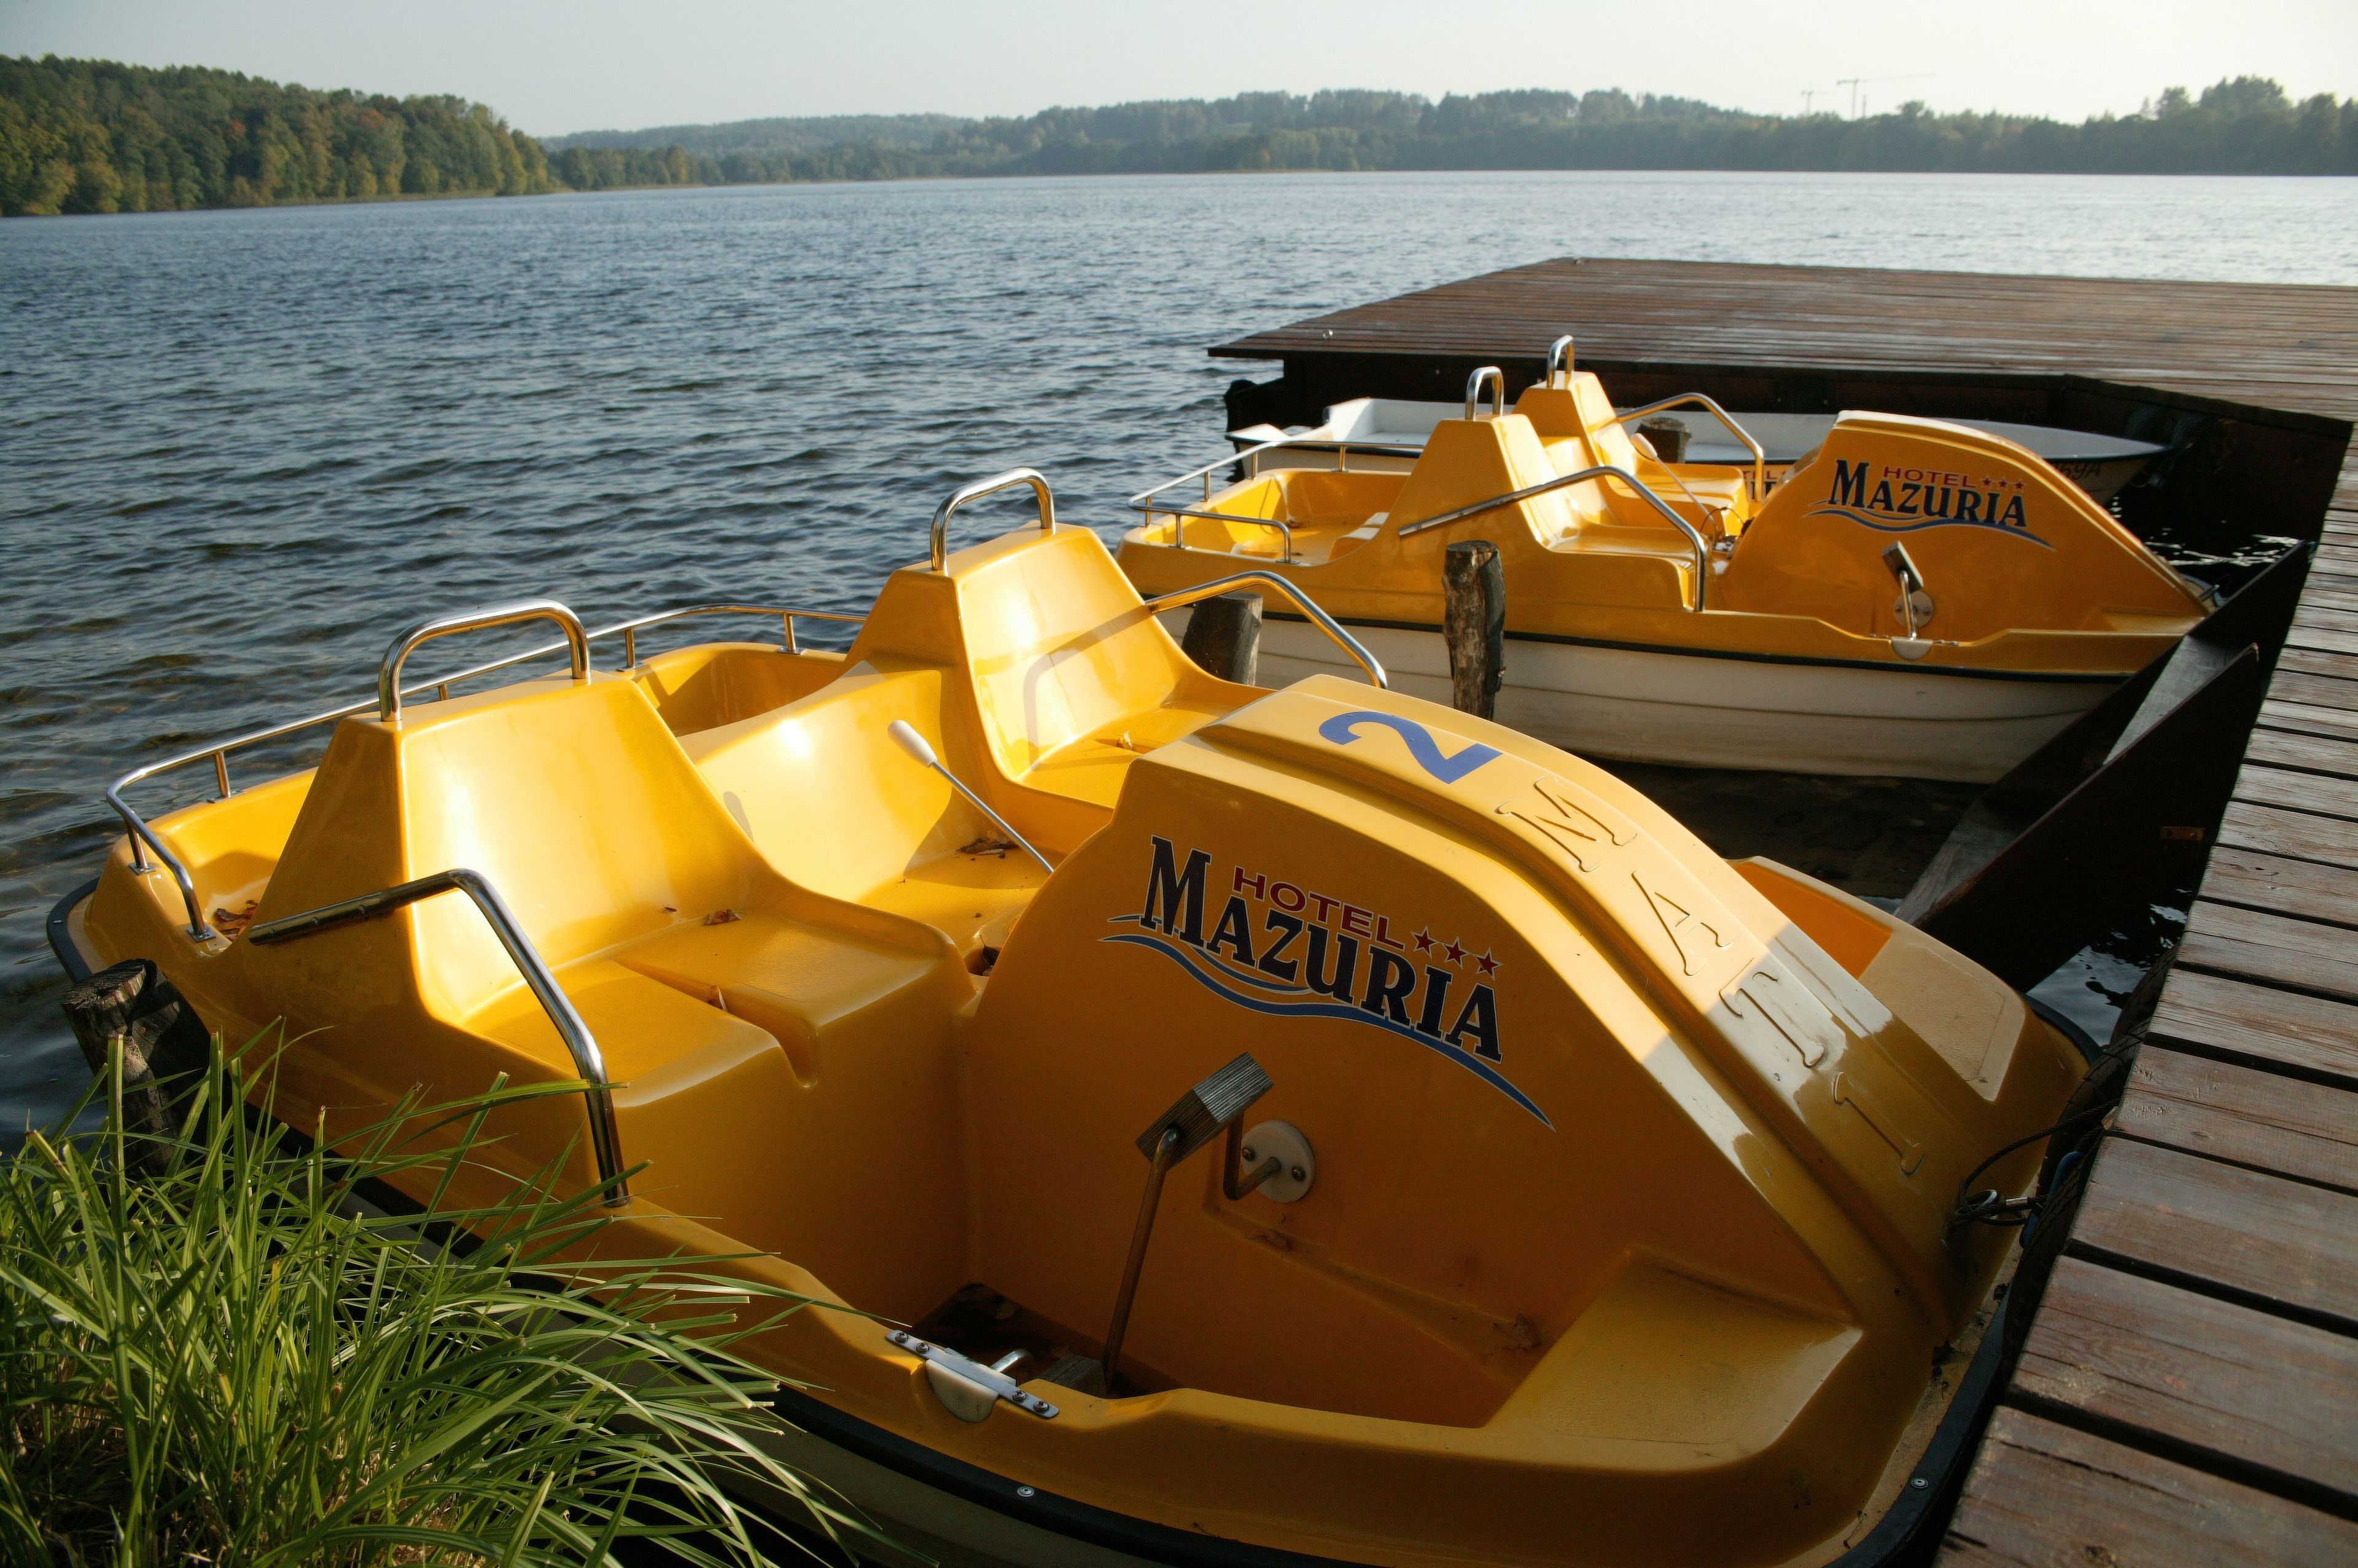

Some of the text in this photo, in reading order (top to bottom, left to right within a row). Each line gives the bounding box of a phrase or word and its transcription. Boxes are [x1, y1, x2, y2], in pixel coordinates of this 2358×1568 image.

[1828, 459, 2027, 527] MAZURIA
[1883, 466, 1977, 488] HOTEL
[1318, 711, 1503, 785] 2
[1232, 865, 1405, 951] HOTEL
[1140, 834, 1503, 1066] MAZURIA
